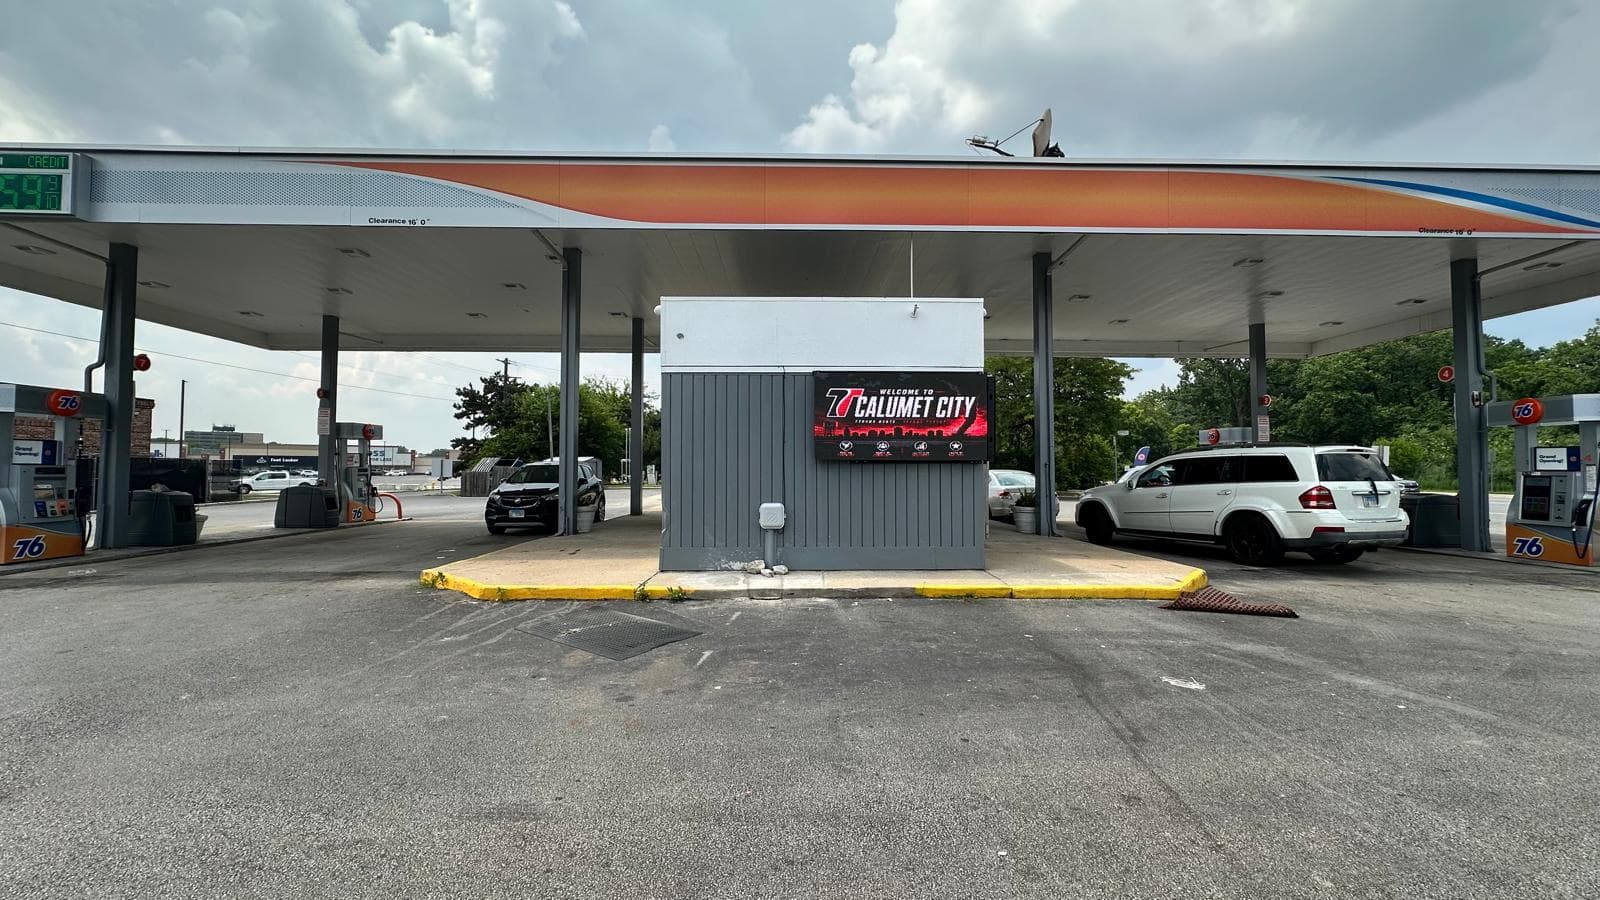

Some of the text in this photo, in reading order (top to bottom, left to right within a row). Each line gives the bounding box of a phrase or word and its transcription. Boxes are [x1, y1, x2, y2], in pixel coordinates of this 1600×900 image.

[28, 156, 67, 168] CREDIT
[368, 217, 406, 225] Clearance
[58, 396, 80, 410] 76
[855, 396, 976, 418] CALUMET CITY
[1514, 405, 1534, 418] 76
[352, 507, 363, 520] 76
[13, 535, 46, 560] 76
[1513, 536, 1544, 558] 76
